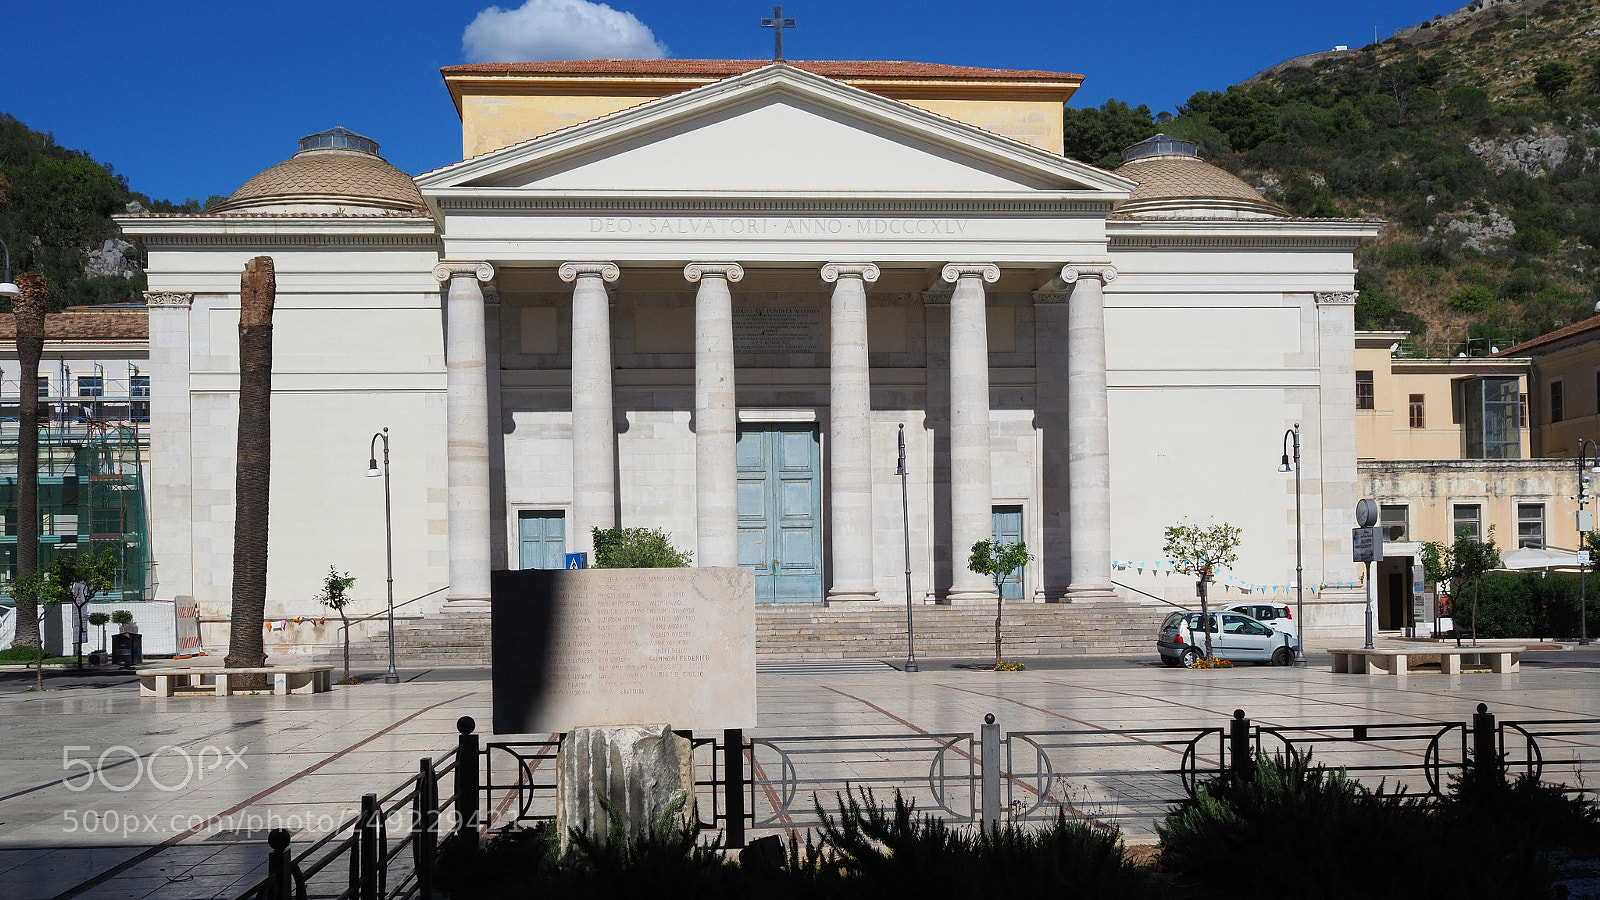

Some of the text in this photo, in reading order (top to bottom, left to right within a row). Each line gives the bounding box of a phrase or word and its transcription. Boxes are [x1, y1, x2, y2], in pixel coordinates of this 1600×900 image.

[589, 218, 969, 234] DEO SALVATORI ANNO MDCCCXLV
